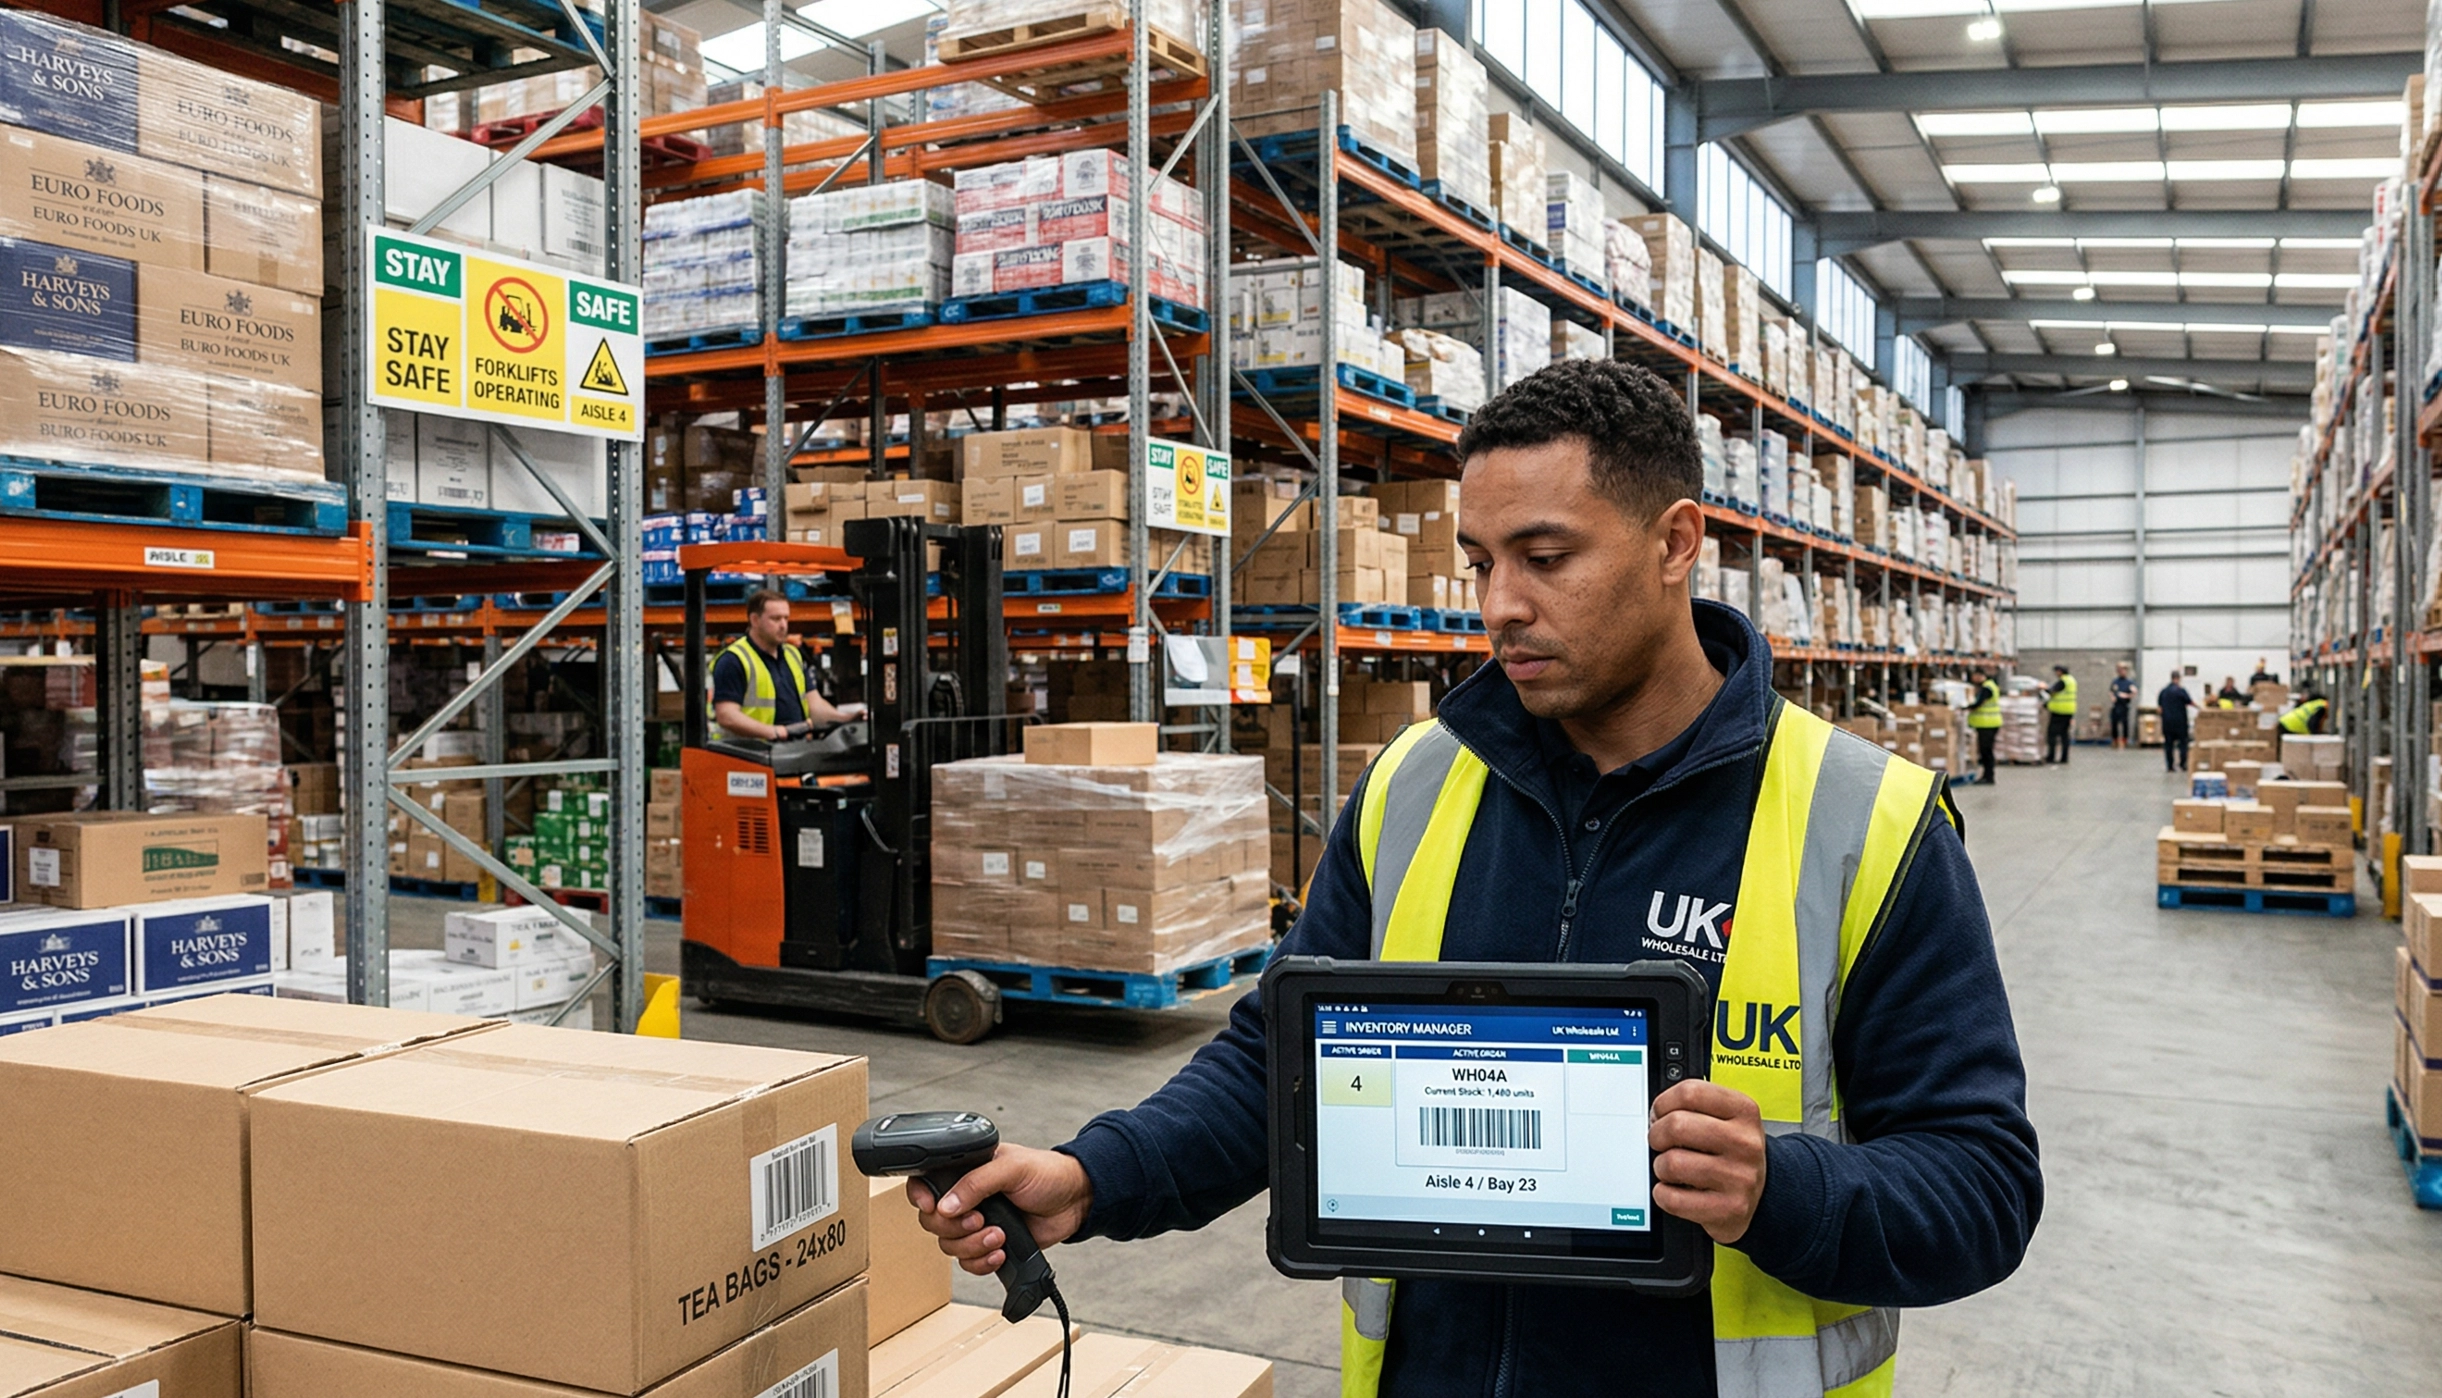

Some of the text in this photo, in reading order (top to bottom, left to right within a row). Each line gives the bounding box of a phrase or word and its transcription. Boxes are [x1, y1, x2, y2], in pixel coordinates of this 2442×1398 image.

[20, 46, 113, 85] HARVEYS
[32, 69, 105, 101] & SONS
[177, 100, 294, 144] EURO FOODS
[272, 153, 290, 168] UK
[31, 174, 90, 201] EURO
[97, 188, 165, 217] FOODS
[33, 206, 79, 226] EURO
[83, 216, 136, 238] FOODS
[140, 228, 162, 243] UK
[385, 247, 451, 287] STAY
[21, 271, 111, 301] HARVEYS
[32, 291, 102, 316] & SONS
[576, 291, 631, 326] SAFE
[180, 308, 231, 332] EURO
[236, 319, 294, 342] FOODS
[387, 326, 450, 361] STAY
[271, 353, 291, 367] UK
[475, 357, 559, 387] FORKLIFTS
[386, 359, 451, 394] SAFE
[38, 391, 171, 422] EURO FOODS
[474, 380, 560, 410] OPERATING
[581, 403, 627, 423] AISLE 4
[90, 428, 142, 444] FOODS
[145, 433, 167, 448] UK
[1646, 890, 1732, 949] UK
[171, 932, 247, 955] HARVEYS
[180, 947, 240, 968] & SONS
[1641, 937, 1708, 961] WHOLESALE
[11, 951, 99, 976] HARVEYS
[21, 968, 91, 990] & SONS
[1346, 1021, 1410, 1034] INVENTORY
[1716, 1000, 1800, 1055] UK
[1452, 1068, 1507, 1082] WH04A
[1717, 1054, 1780, 1069] WHOLESALE
[1350, 1075, 1363, 1092] 4
[1424, 1086, 1456, 1096] Current
[1513, 1089, 1535, 1098] units
[1425, 1174, 1537, 1194] Aisle 4 / Bay 23
[678, 1281, 720, 1326] TEA
[725, 1252, 781, 1304] BAGS
[797, 1219, 847, 1268] 24x80
